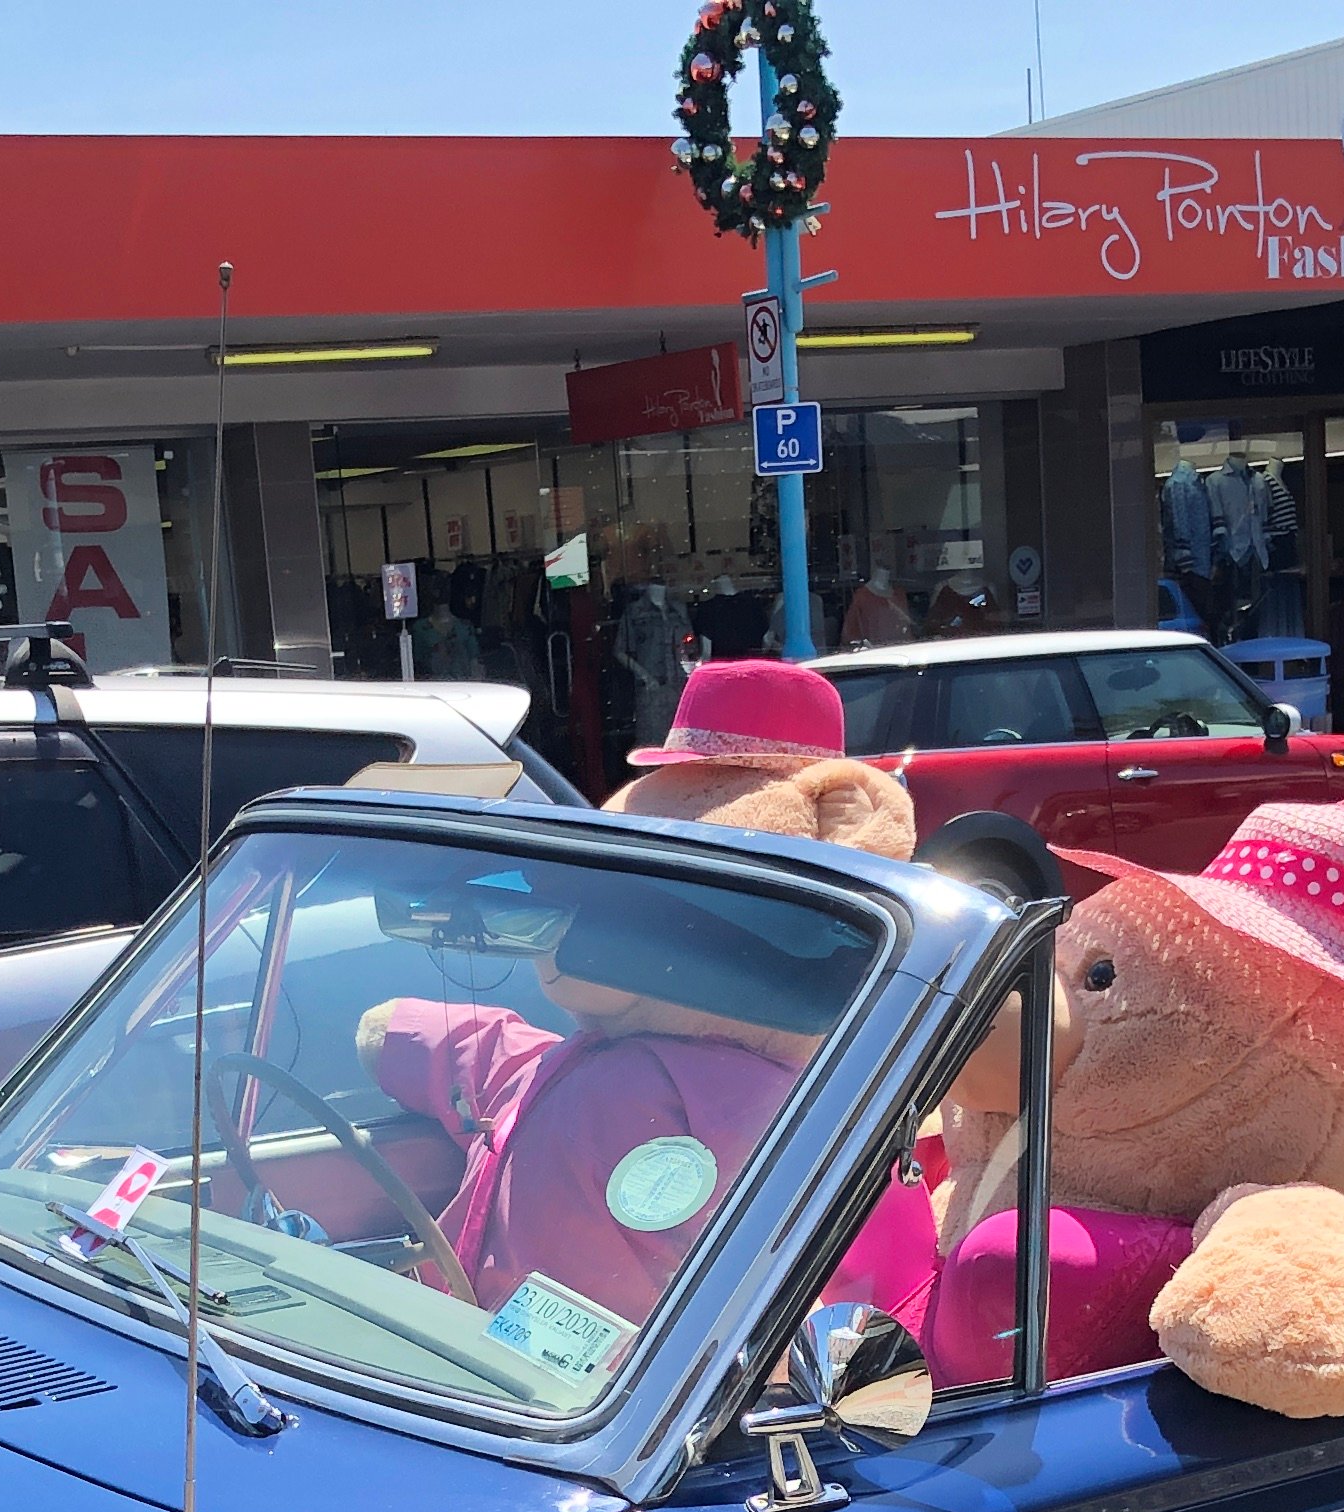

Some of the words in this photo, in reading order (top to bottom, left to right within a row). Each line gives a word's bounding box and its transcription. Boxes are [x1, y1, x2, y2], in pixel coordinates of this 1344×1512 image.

[935, 149, 1141, 280] Hilary
[1075, 149, 1334, 258] Pointon
[776, 409, 797, 435] P
[777, 438, 800, 459] 60
[512, 1286, 598, 1340] 23/10/2020
[493, 1315, 532, 1344] FK4709
